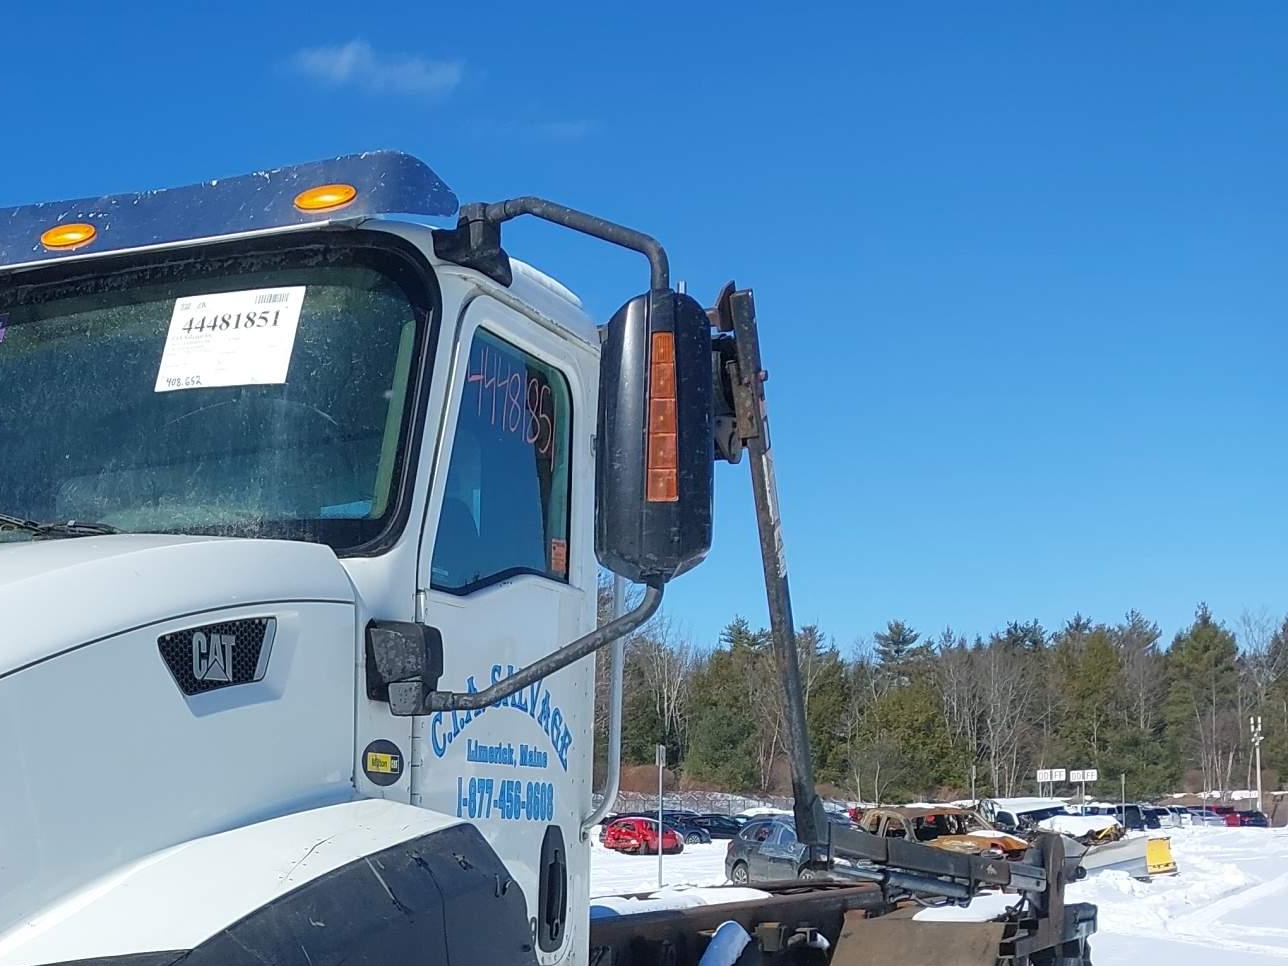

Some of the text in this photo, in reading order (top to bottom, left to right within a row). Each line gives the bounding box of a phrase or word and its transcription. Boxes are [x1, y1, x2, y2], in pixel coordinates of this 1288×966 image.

[182, 309, 281, 334] 44481851
[192, 631, 236, 682] CAT
[466, 738, 548, 769] Limerick, Maine
[456, 776, 554, 822] 1-877-456-8608
